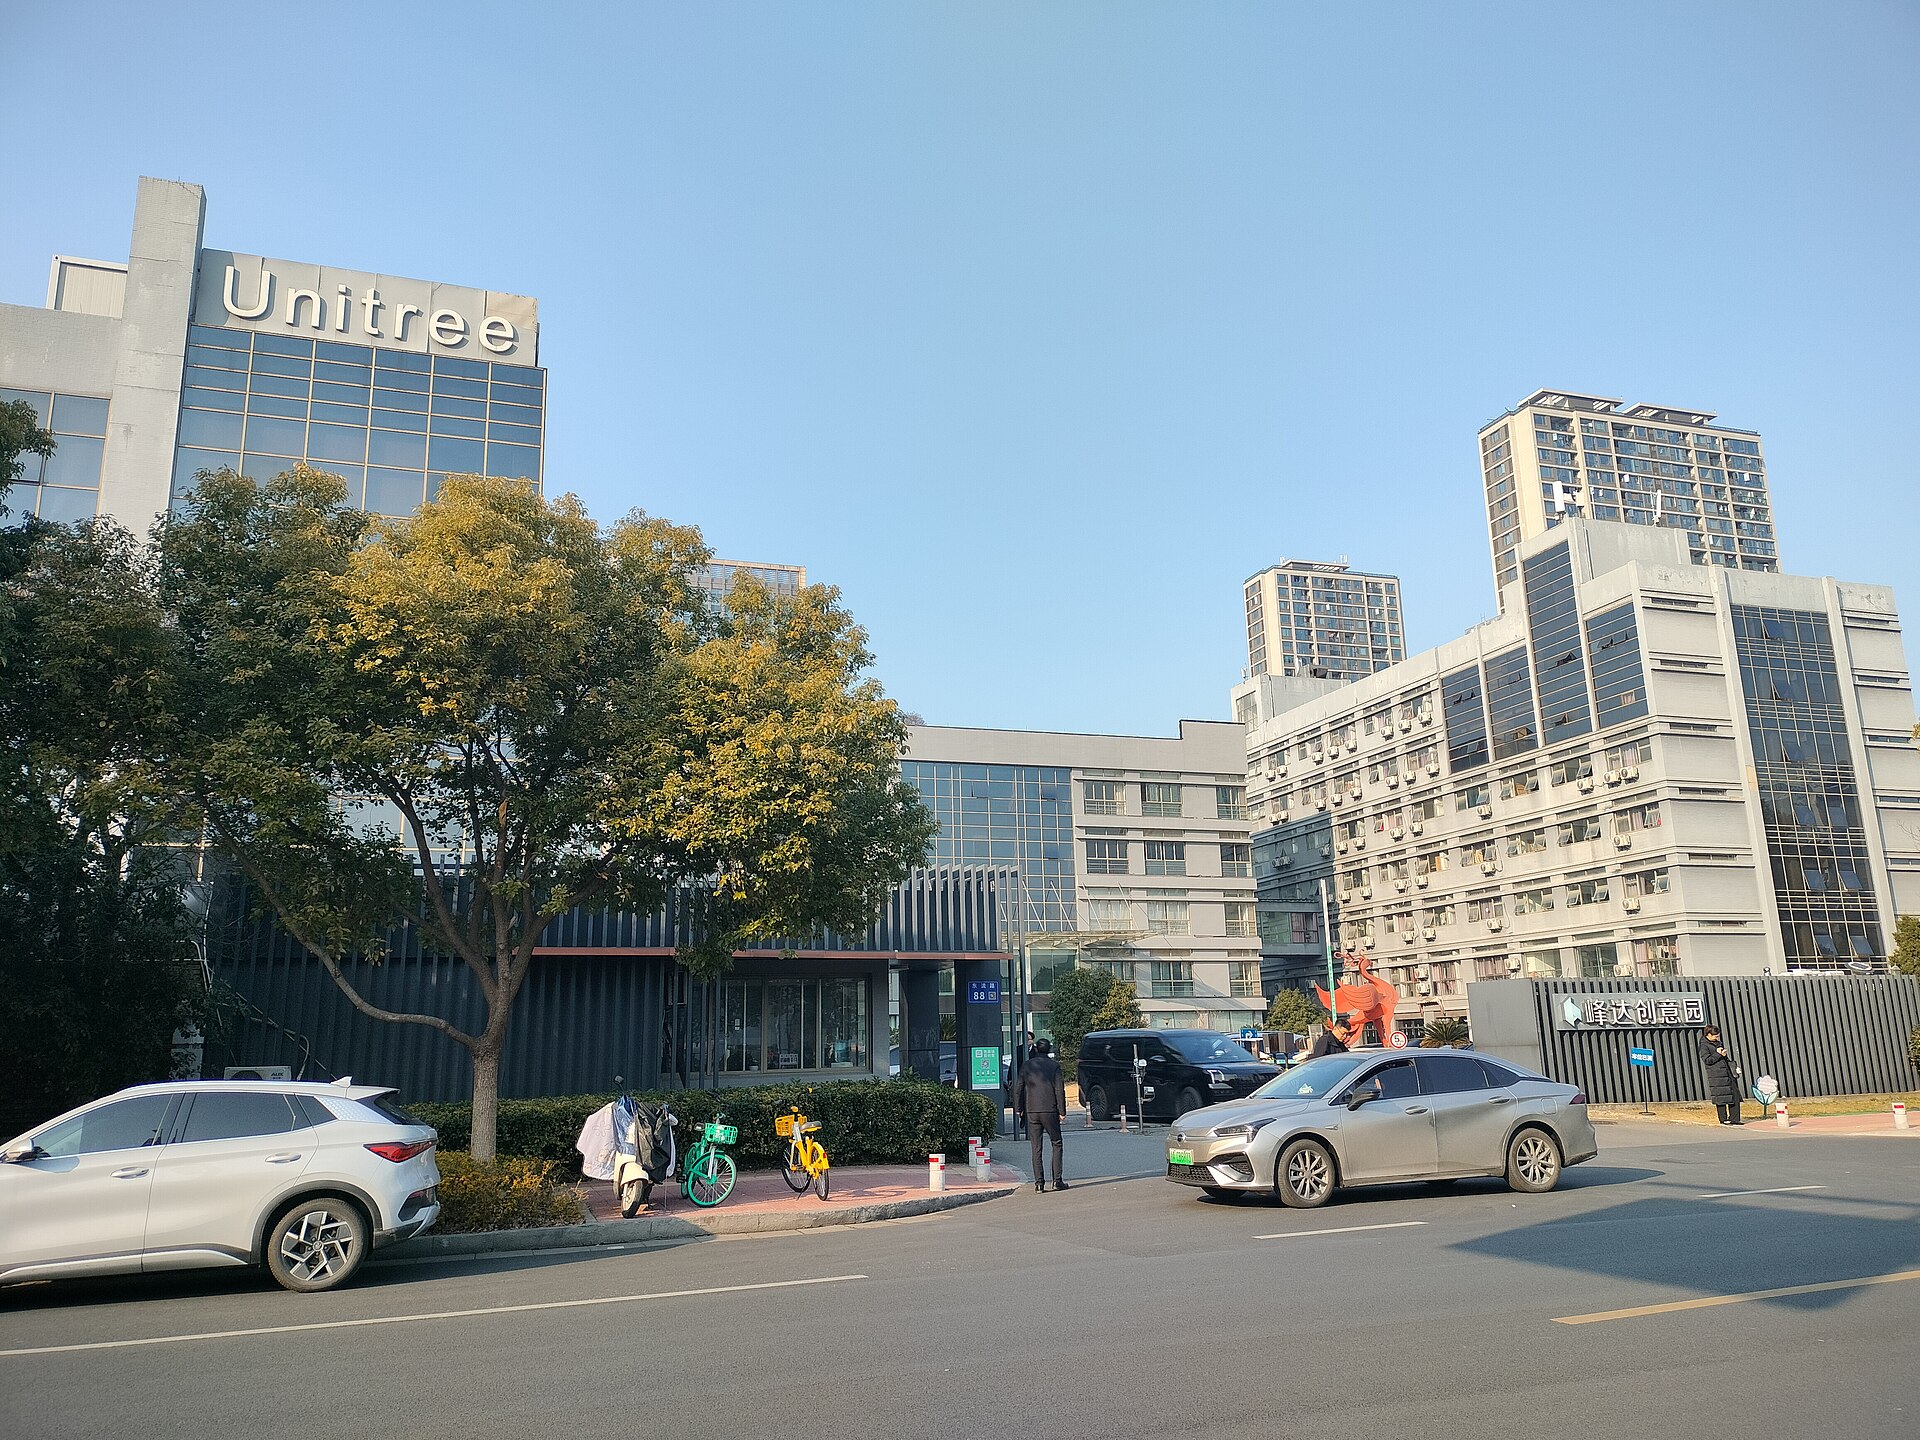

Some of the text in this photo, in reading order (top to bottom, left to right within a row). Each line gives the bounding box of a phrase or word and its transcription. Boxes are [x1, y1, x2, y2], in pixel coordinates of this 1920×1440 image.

[223, 265, 514, 352] Unitree
[973, 991, 985, 1000] 88
[1585, 998, 1704, 1025] 峰达创意园
